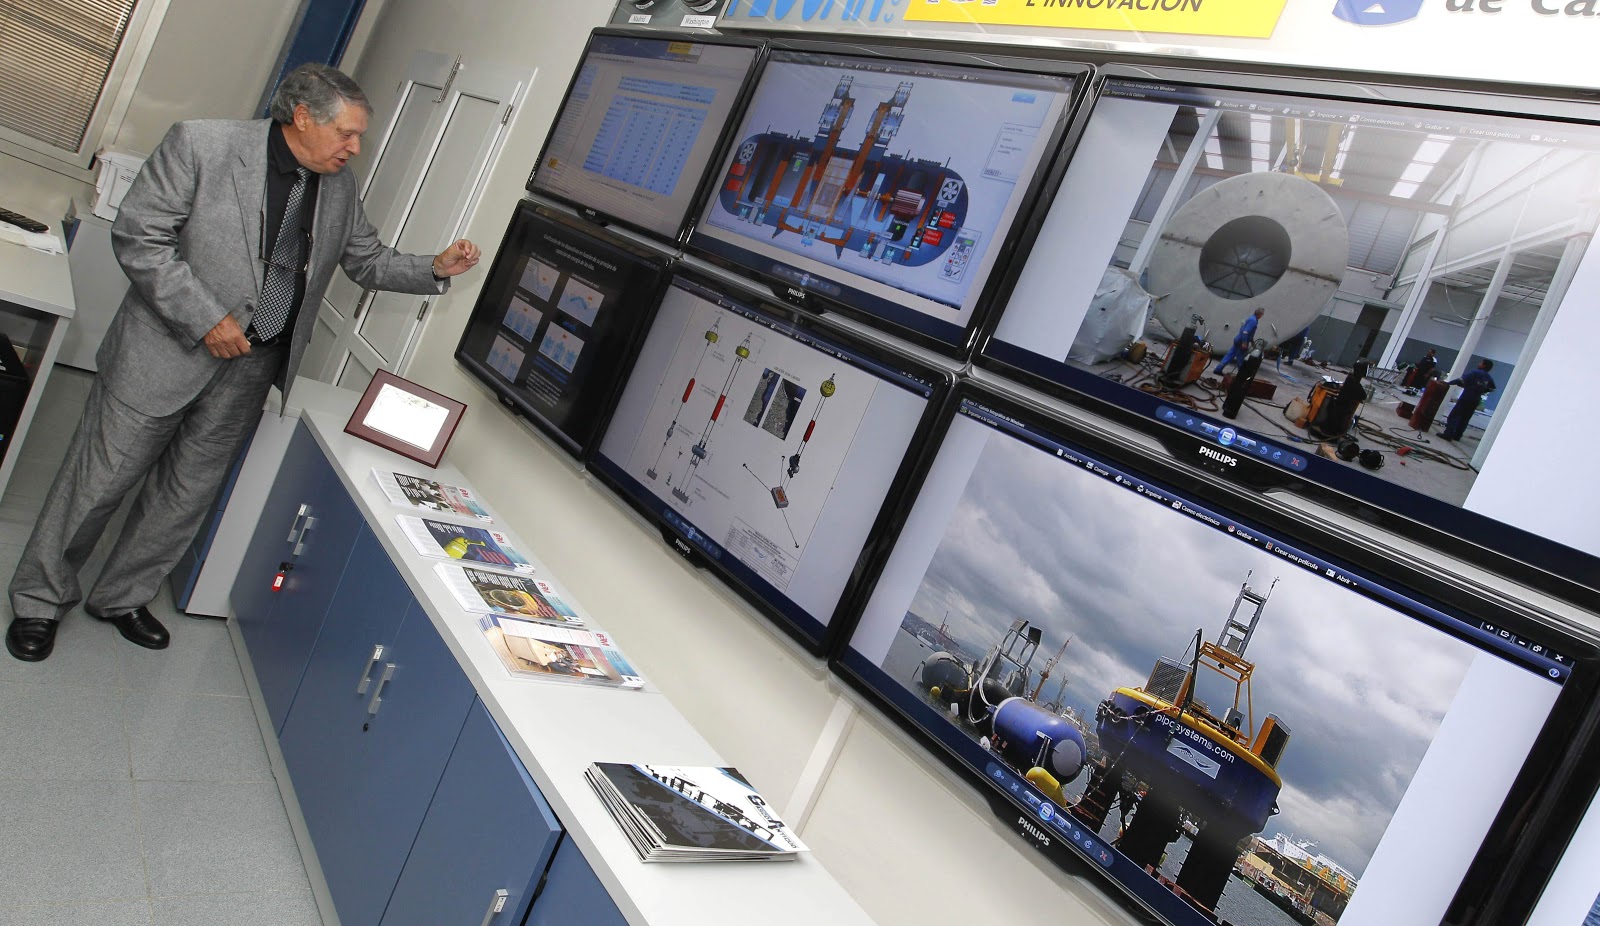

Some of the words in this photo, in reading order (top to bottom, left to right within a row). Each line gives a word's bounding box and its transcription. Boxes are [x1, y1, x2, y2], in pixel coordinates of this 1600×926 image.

[788, 287, 805, 299] PHILIPS
[1199, 446, 1237, 467] PHILIPS
[1182, 505, 1196, 516] Correo
[1236, 530, 1253, 540] Grabar
[1274, 546, 1288, 556] Crear
[1298, 558, 1319, 570] película
[1336, 575, 1351, 584] Abrir
[1018, 816, 1050, 846] PHILIPS
